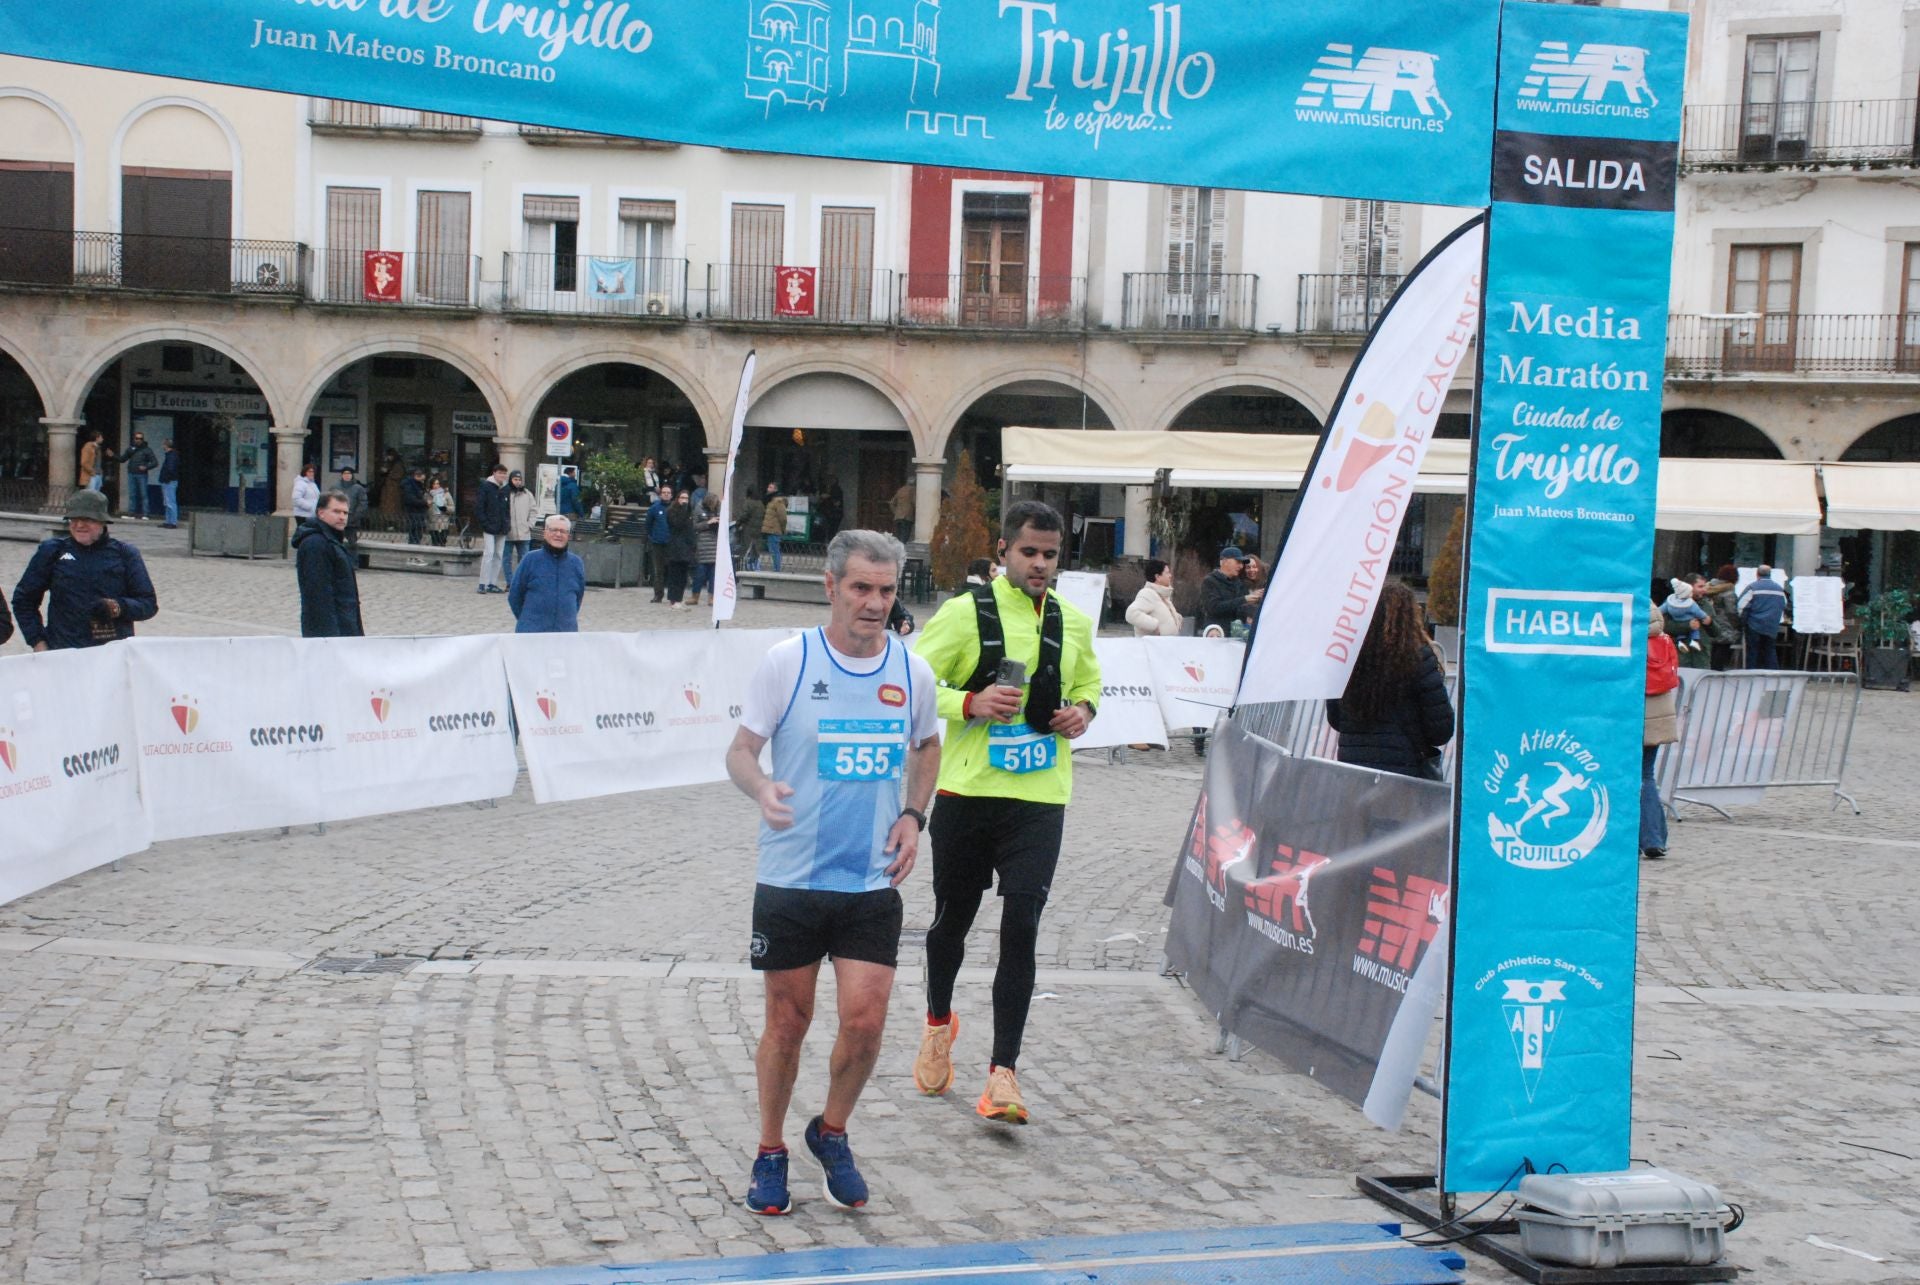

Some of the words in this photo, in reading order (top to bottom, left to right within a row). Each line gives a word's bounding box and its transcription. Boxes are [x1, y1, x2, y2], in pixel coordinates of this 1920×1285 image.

[251, 19, 318, 50] Juan
[326, 30, 425, 66] Mateos
[433, 45, 556, 83] Broncano
[998, 0, 1216, 119] Trujillo
[1045, 94, 1070, 130] te
[1295, 109, 1445, 133] www.musicrun.es
[1516, 97, 1650, 119] www.musicrun.es
[1523, 154, 1646, 192] SALIDA
[1507, 301, 1641, 340] Media
[1497, 354, 1649, 391] Maratón
[1512, 401, 1590, 429] Ciudad
[1592, 408, 1624, 430] de
[1491, 432, 1640, 499] Trujillo
[1493, 504, 1524, 519] Juan
[1526, 504, 1574, 520] Mateos
[1577, 507, 1636, 523] Broncano
[1325, 474, 1407, 664] DIPUTACIÓN
[1396, 426, 1424, 466] DE
[1505, 608, 1610, 638] HABLA
[835, 746, 891, 775] 555
[1004, 743, 1047, 771] 519
[1484, 749, 1510, 793] Club
[1520, 729, 1600, 772] Atletismo
[1474, 968, 1496, 991] Club
[1497, 955, 1551, 973] Athletico
[1553, 958, 1577, 973] San
[1577, 967, 1604, 990] José
